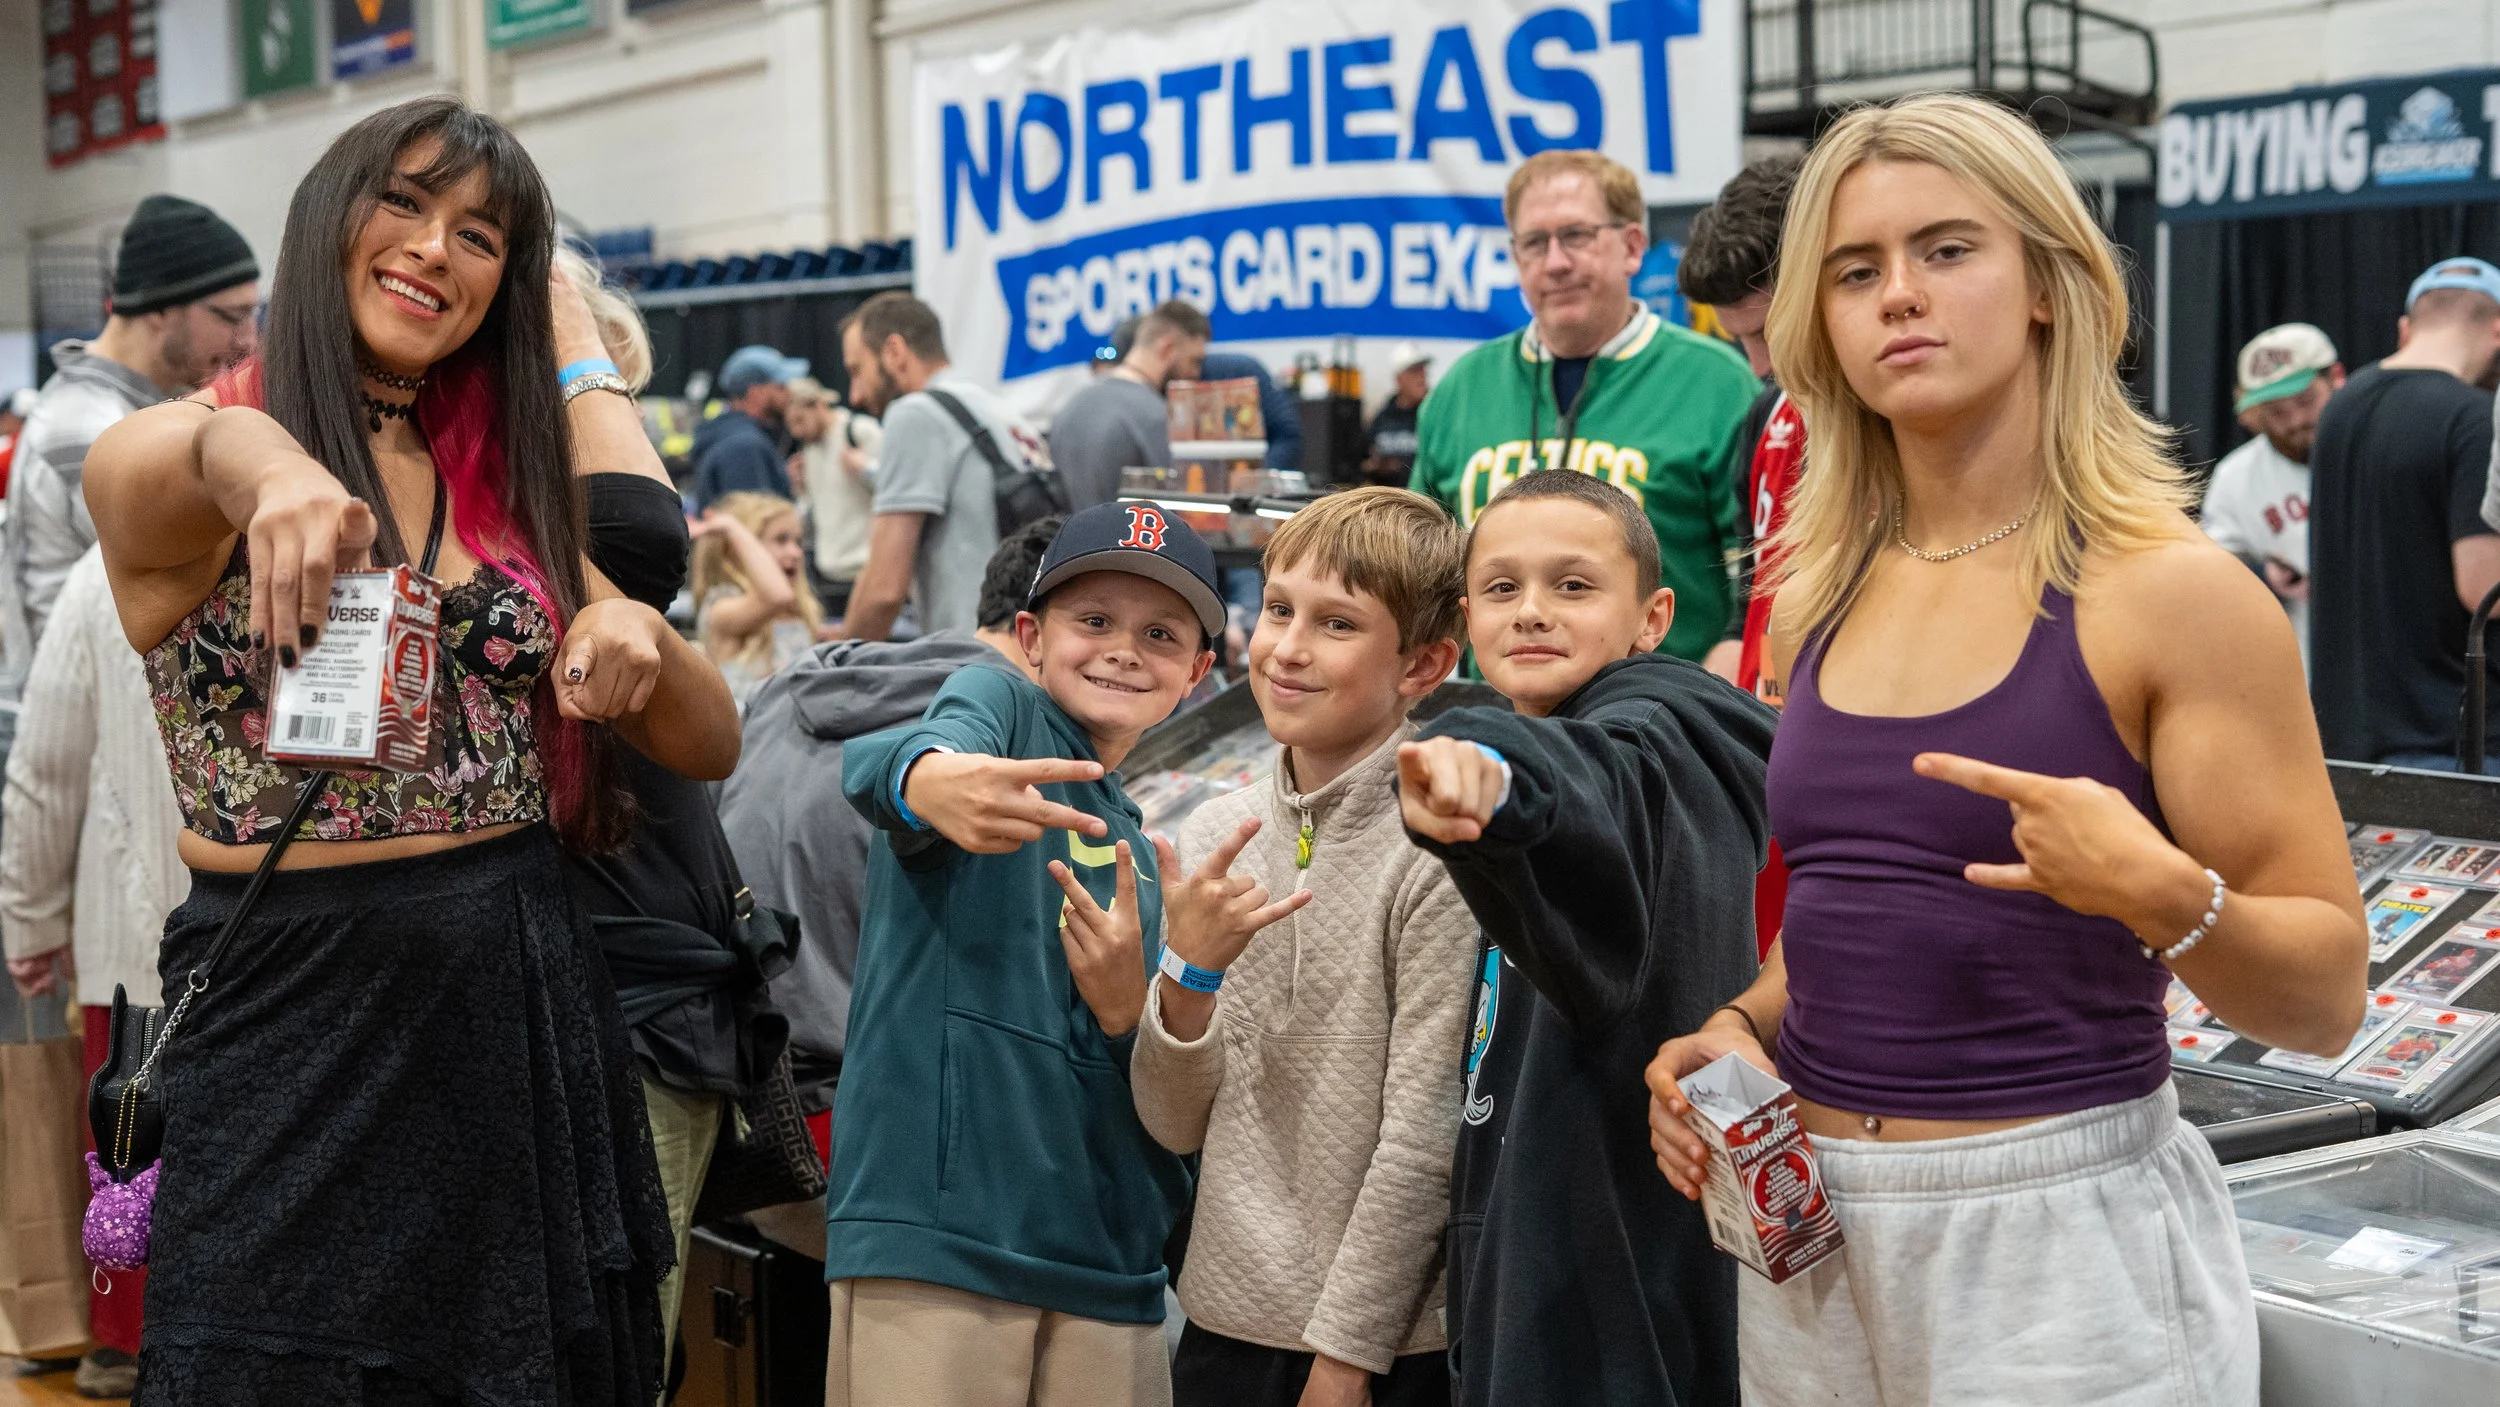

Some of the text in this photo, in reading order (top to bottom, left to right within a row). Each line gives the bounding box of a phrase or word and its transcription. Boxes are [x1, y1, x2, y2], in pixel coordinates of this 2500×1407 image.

[942, 0, 1701, 252] NORTHEAST
[2157, 94, 2370, 207] BUYING
[1025, 223, 1521, 353] SPORTS CARD EXP
[1119, 505, 1169, 550] B
[328, 605, 379, 623] VERSE
[311, 692, 326, 703] 36
